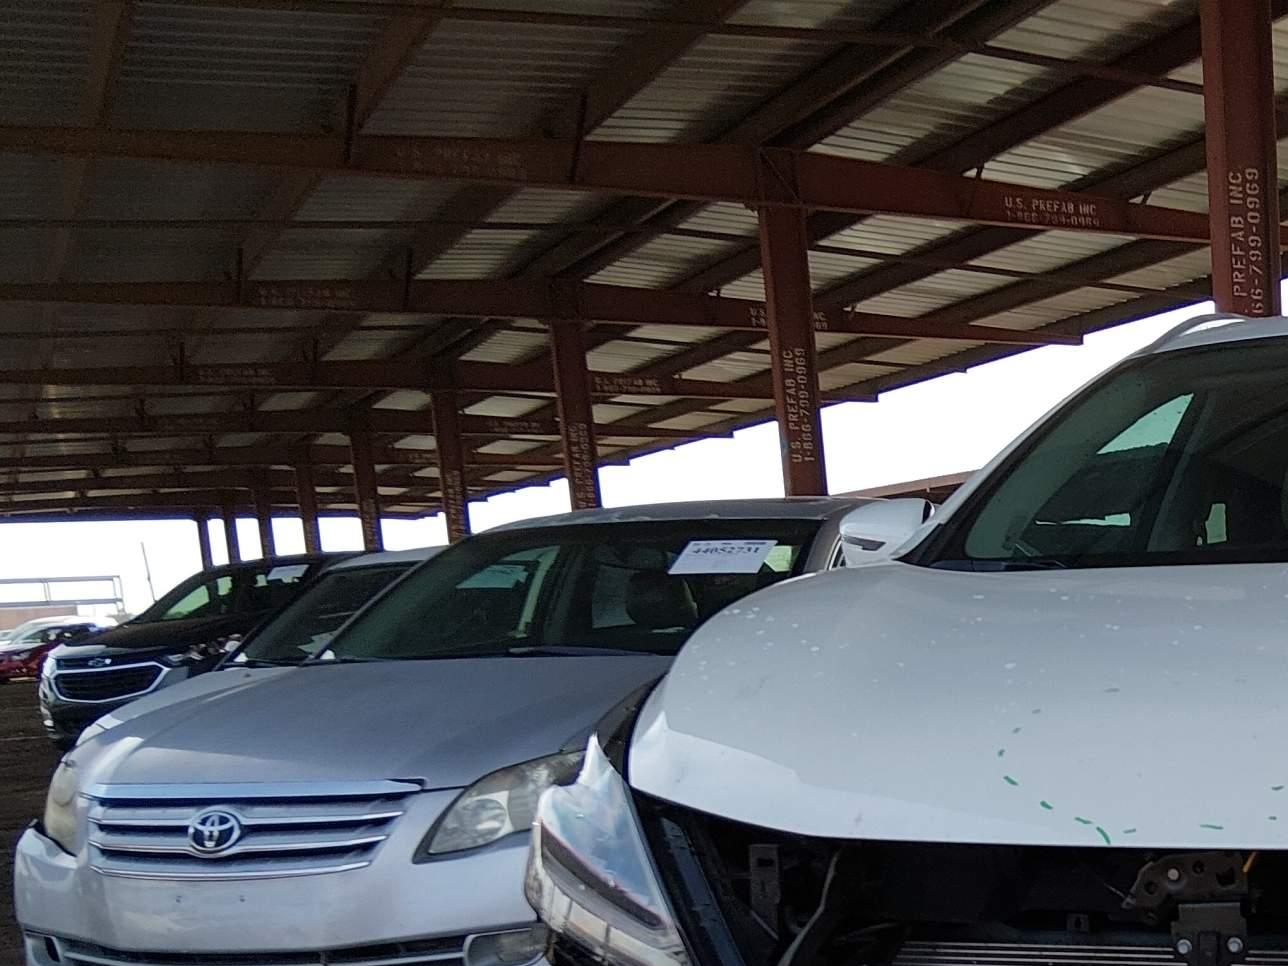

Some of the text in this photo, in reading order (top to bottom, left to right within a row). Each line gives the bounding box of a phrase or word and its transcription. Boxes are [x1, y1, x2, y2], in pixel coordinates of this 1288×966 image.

[1032, 199, 1075, 214] PREFAB
[1080, 203, 1097, 216] INC
[1228, 170, 1248, 297] PREFAB INC
[783, 349, 795, 373] INC
[784, 378, 800, 431] PREFAB
